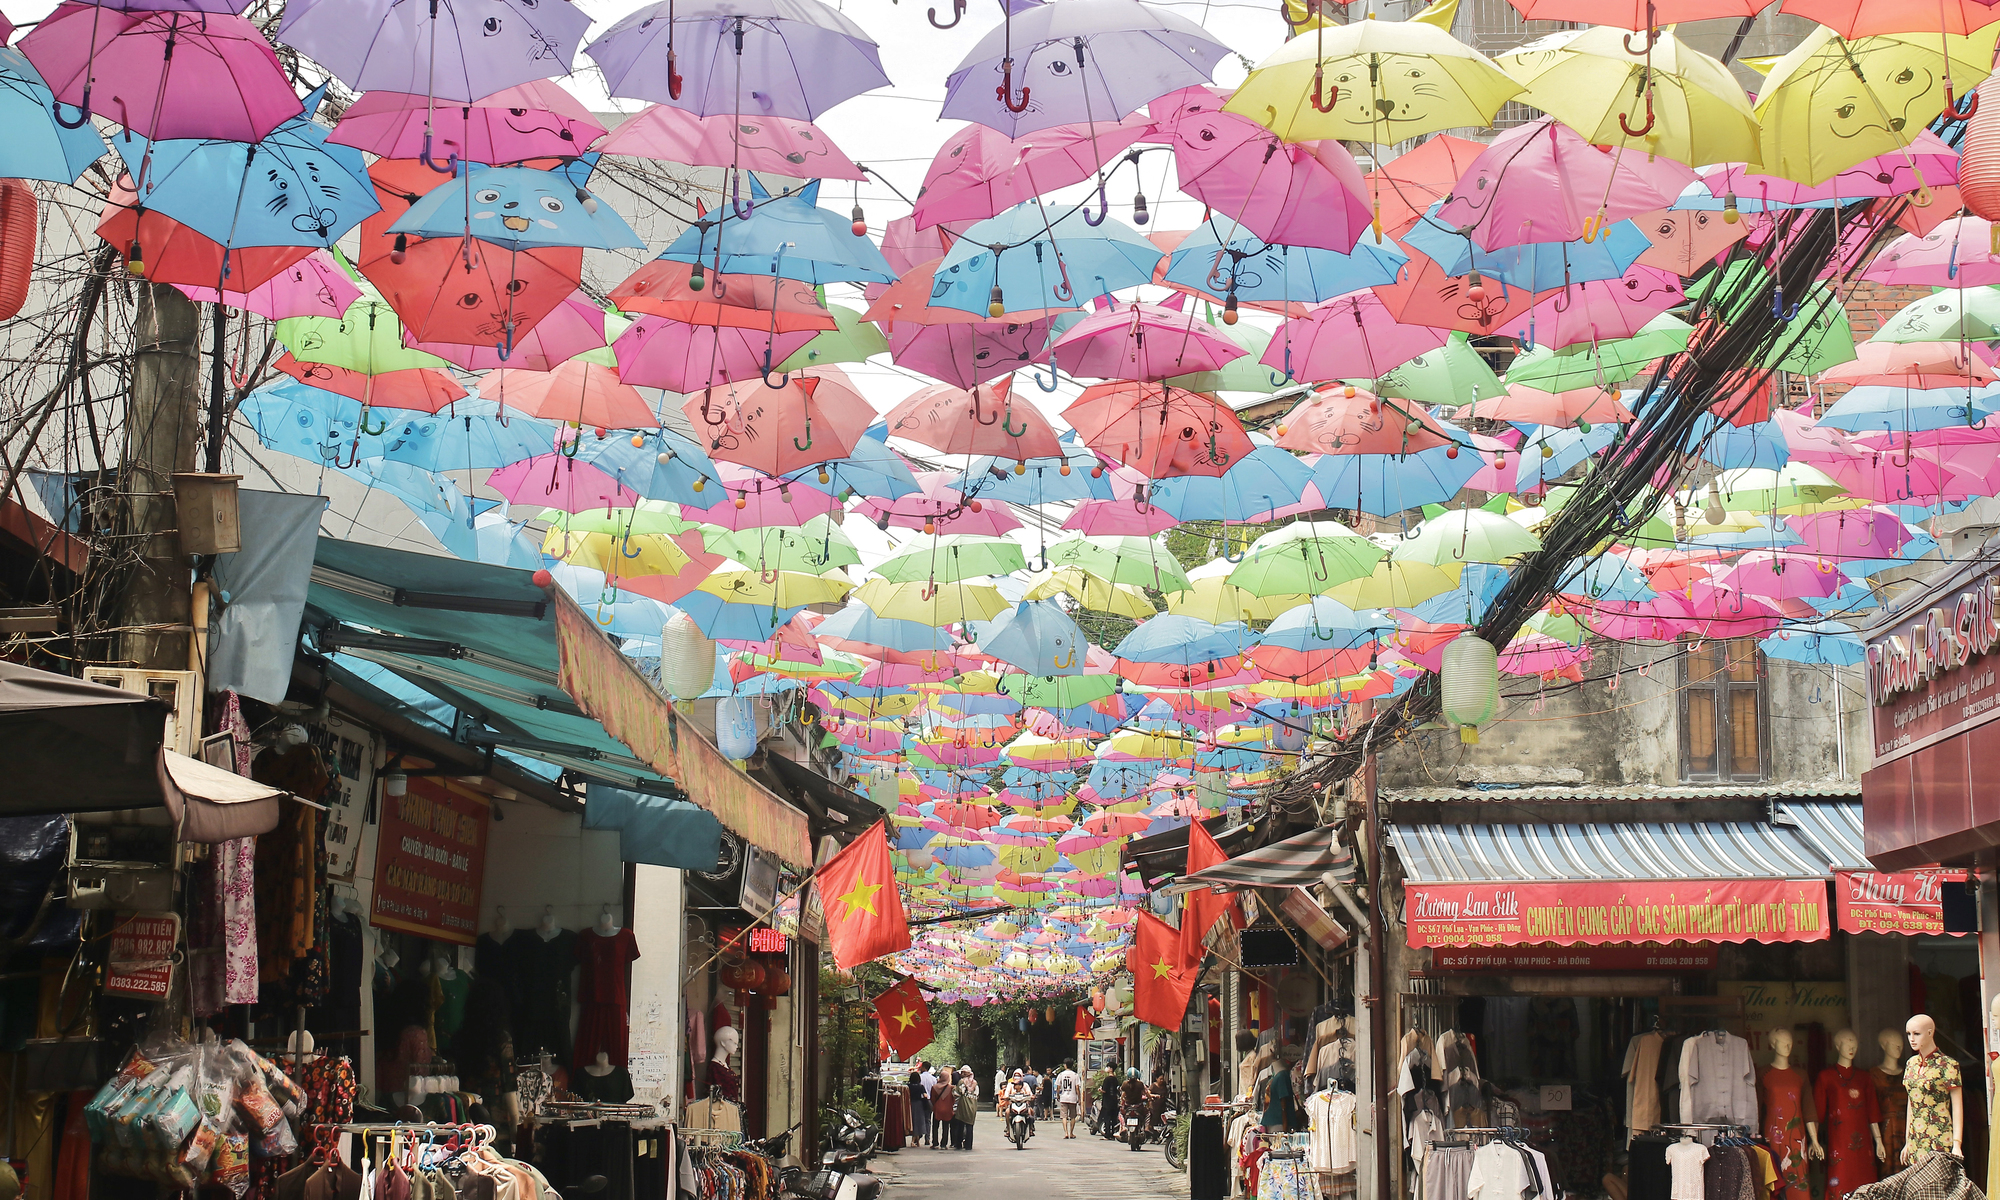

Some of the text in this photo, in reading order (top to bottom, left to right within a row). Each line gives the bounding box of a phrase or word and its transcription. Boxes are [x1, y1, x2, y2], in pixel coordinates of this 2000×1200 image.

[1848, 872, 1907, 907] Thúy
[1414, 891, 1519, 922] Hương Lan Silk
[1526, 888, 1820, 939] CHUYÊN CUNG CẤP CÁC SẢN PHẨM TỪ LỤA TƠ TẰM
[1850, 909, 1863, 918] ĐC:
[1864, 908, 1879, 918] Phố
[1879, 910, 1892, 920] Lụa
[1897, 910, 1910, 921] Vạn
[1912, 911, 1930, 920] Phúc
[136, 922, 151, 935] VAY
[1417, 925, 1427, 933] ĐC:
[1437, 925, 1441, 933] 7
[1442, 924, 1452, 933] Phố
[1454, 925, 1464, 934] Lụa
[1468, 925, 1479, 934] Vạn
[1480, 924, 1493, 933] Phúc
[1498, 923, 1506, 932] Hà
[1507, 924, 1521, 934] Đông
[1858, 920, 1877, 929] ĐT:
[1879, 920, 1900, 929] 094
[1903, 921, 1923, 930] 638
[1426, 934, 1502, 943] ĐT: 0904 200 958
[1443, 957, 1456, 965] ĐC:
[1457, 955, 1468, 965] SỐ
[1476, 955, 1491, 965] PHỐ
[1492, 957, 1507, 967] LỤA
[1513, 957, 1529, 967] VẠN
[1531, 955, 1551, 965] PHÚC
[1557, 955, 1568, 965] HÀ
[1569, 956, 1590, 965] ĐÔNG
[1647, 957, 1709, 965] ĐT: 0904 200 958
[110, 976, 166, 992] 0383.222.585
[1741, 985, 1777, 1007] Thu
[1063, 1078, 1072, 1089] 04
